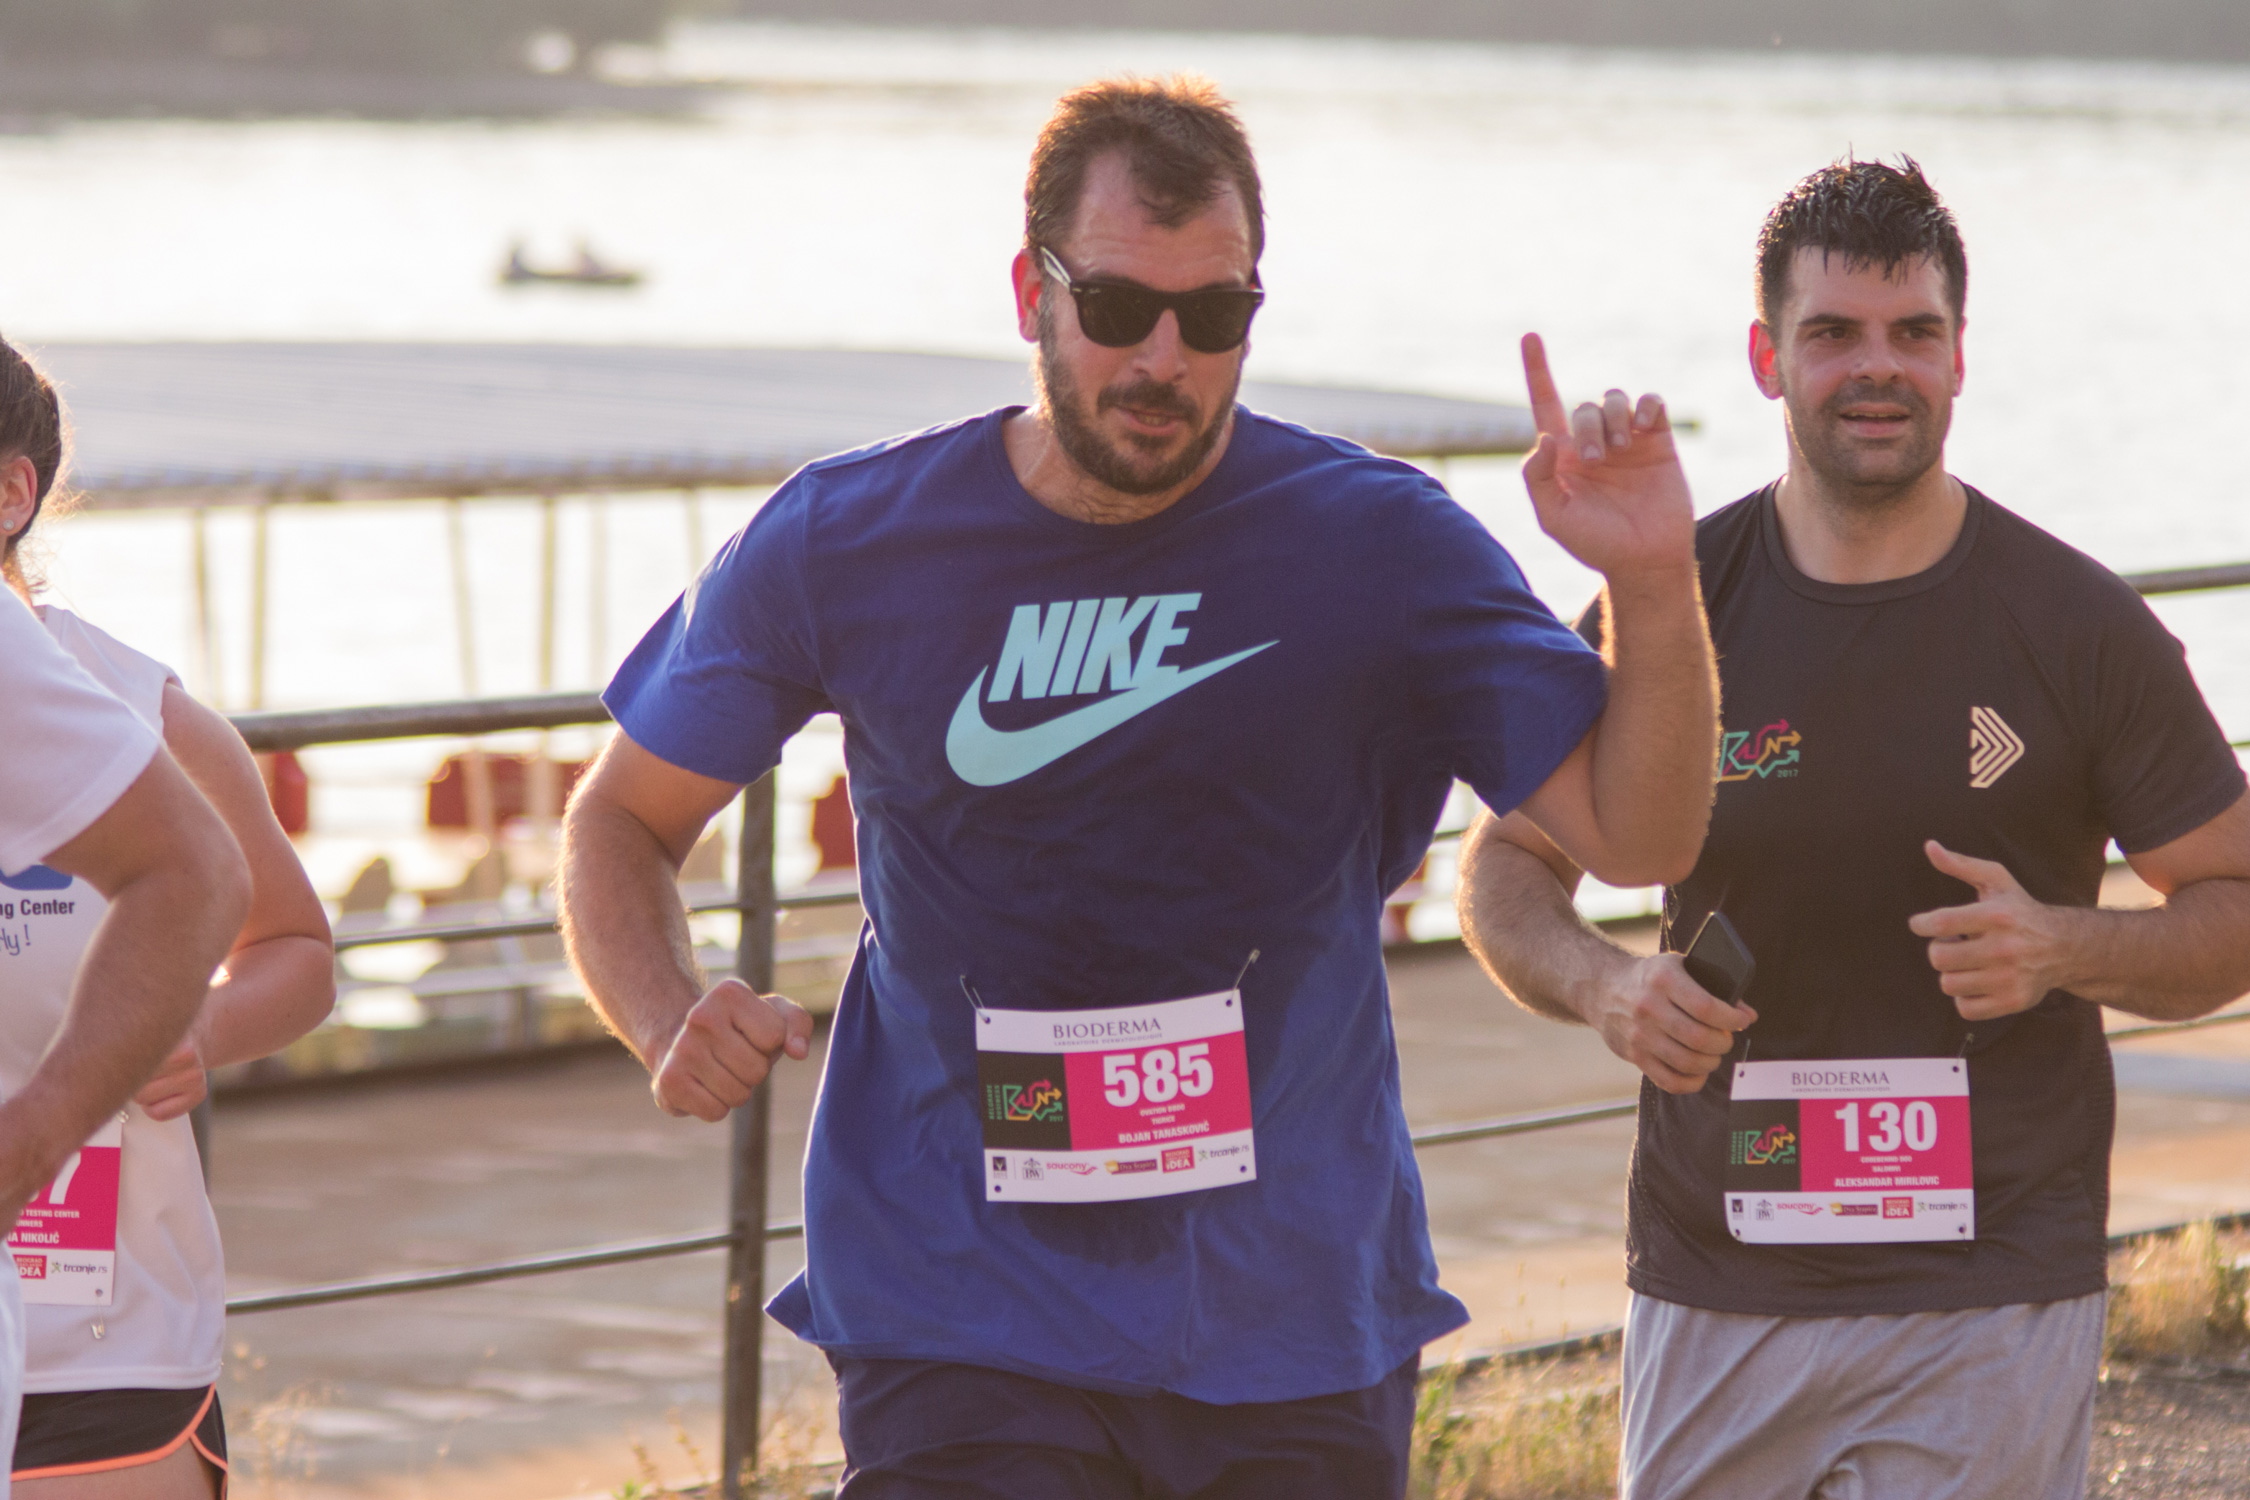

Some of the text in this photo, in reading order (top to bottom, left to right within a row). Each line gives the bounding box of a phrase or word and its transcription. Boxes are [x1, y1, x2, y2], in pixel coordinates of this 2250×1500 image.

[987, 592, 1202, 703] NIKE
[1777, 769, 1798, 778] 2017
[20, 899, 75, 915] Center
[1053, 1017, 1162, 1039] BIODERMA
[1103, 1042, 1214, 1107] 585
[1792, 1071, 1890, 1086] BIODERMA
[1835, 1101, 1938, 1152] 130
[1118, 1131, 1151, 1143] BOJAN
[1046, 1162, 1087, 1171] saucony
[1834, 1177, 1892, 1187] ALEKSANDAR
[26, 1209, 53, 1217] TESTING
[54, 1210, 80, 1218] CENTER
[1777, 1203, 1814, 1211] saucony
[21, 1230, 60, 1244] NIKOLIĆ
